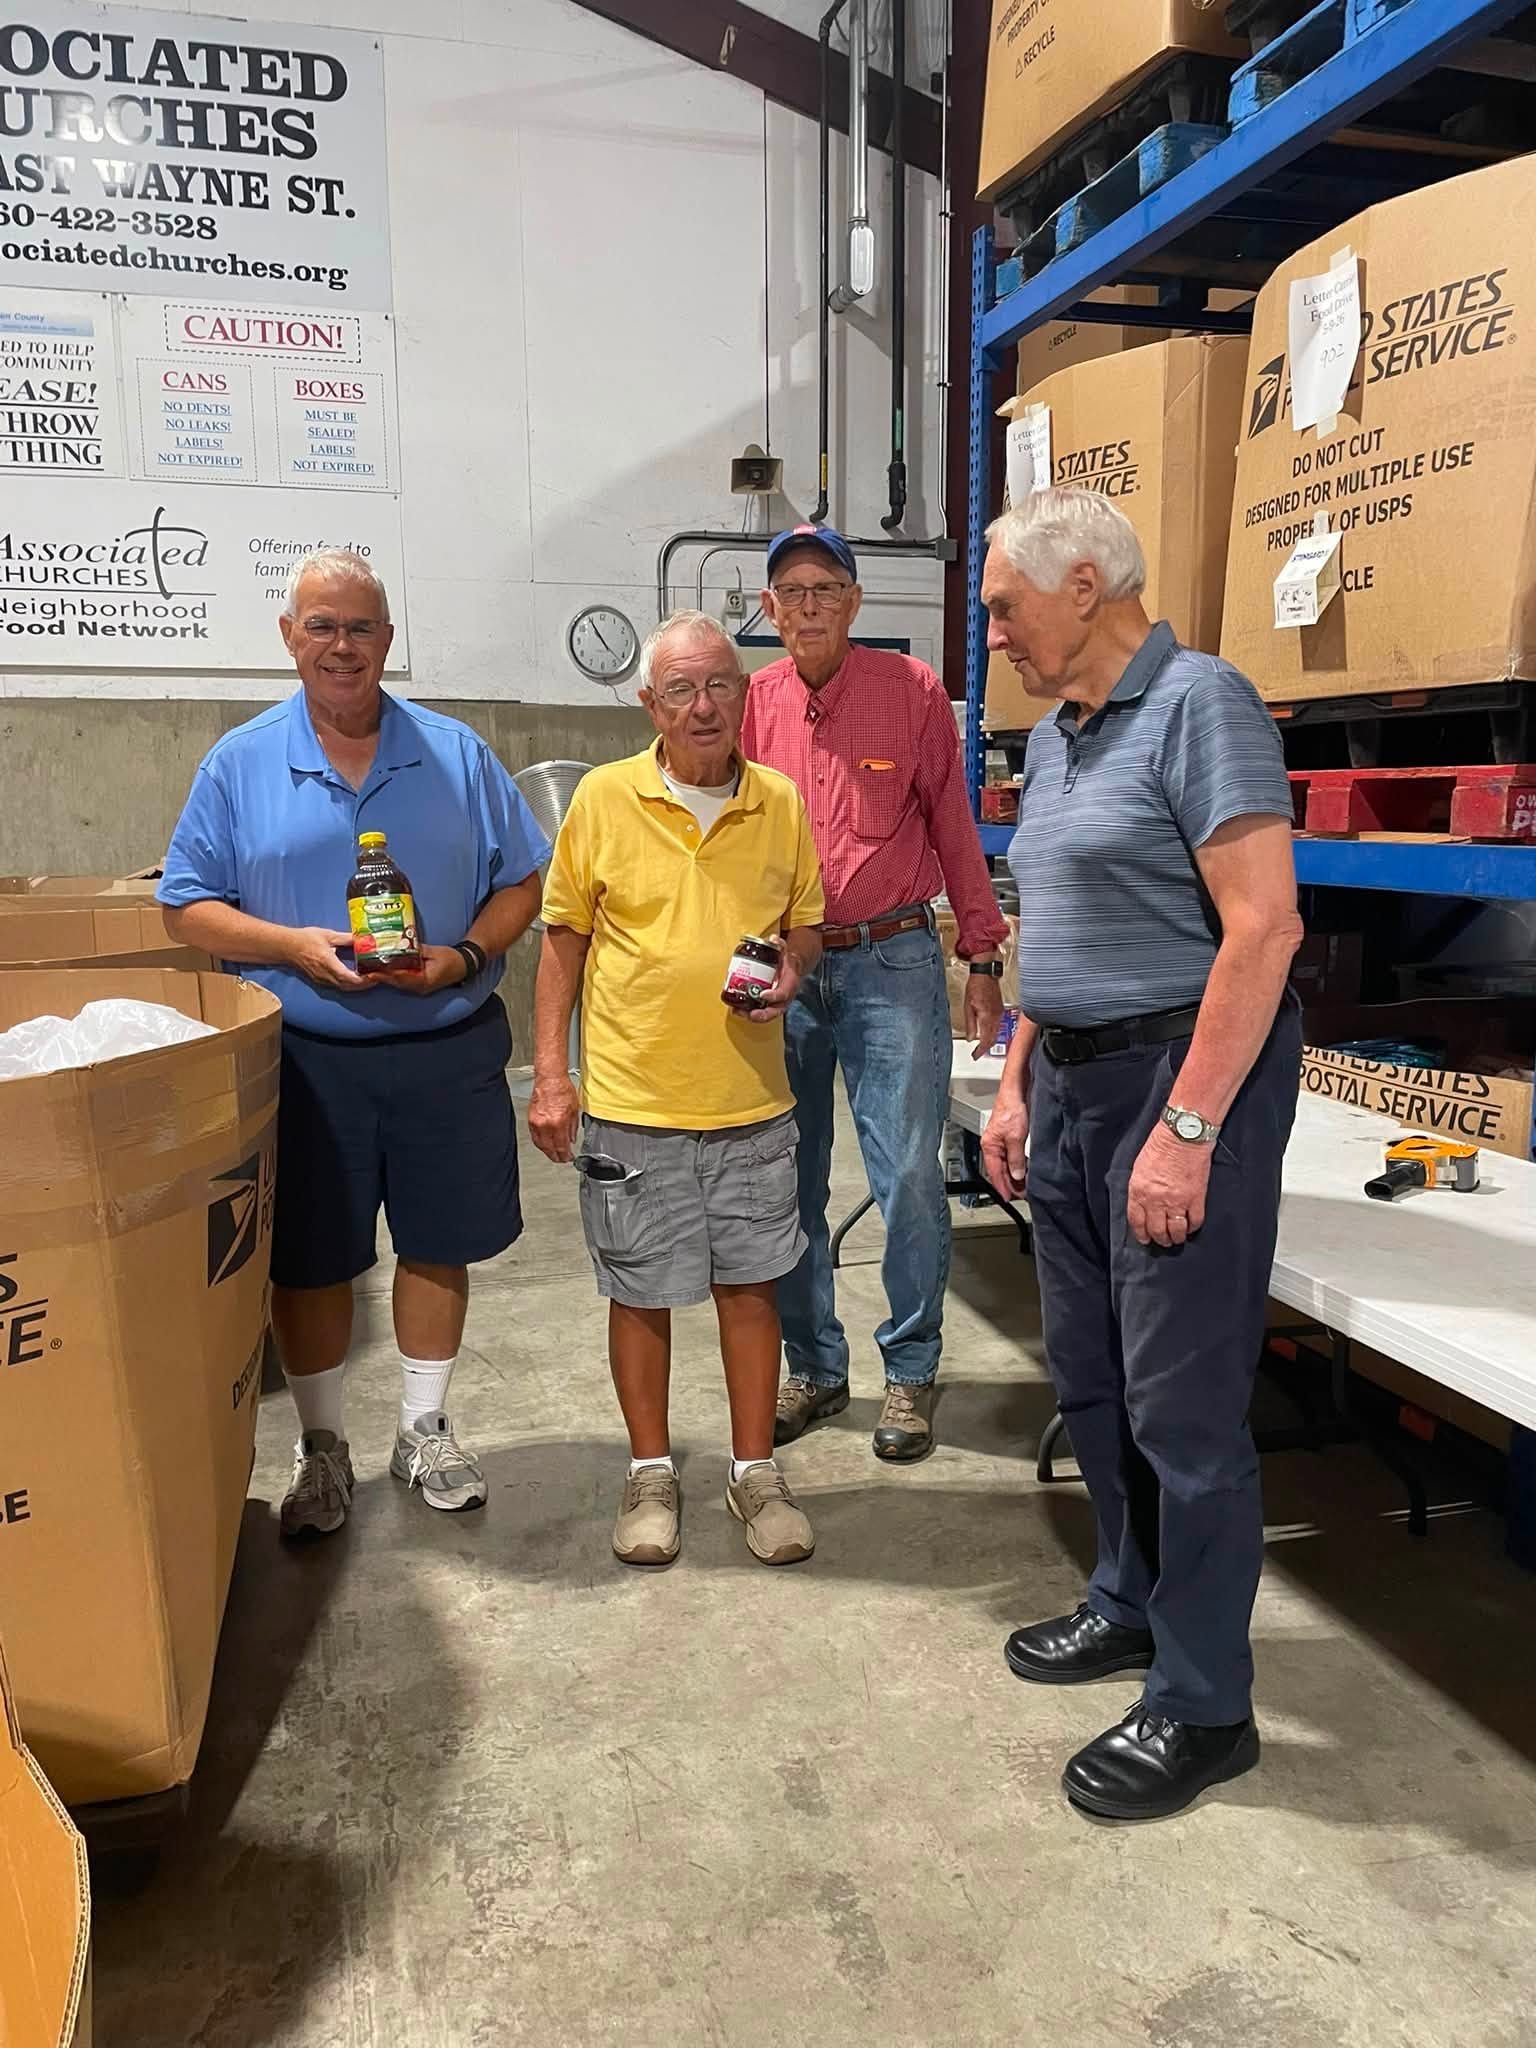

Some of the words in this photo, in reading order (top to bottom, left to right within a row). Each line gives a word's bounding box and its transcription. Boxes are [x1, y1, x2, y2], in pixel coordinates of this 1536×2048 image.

[0, 24, 348, 102] OCIATED
[92, 158, 270, 211] WAYNE
[287, 175, 356, 218] ST.
[2, 238, 348, 291] ociatedchurches.org
[1376, 268, 1508, 340] STATES
[184, 315, 343, 349] CAUTION!
[26, 342, 48, 354] TO
[53, 343, 95, 357] HELP
[1366, 309, 1514, 385] SERVICE
[0, 355, 96, 372] OMMUNITY
[163, 371, 228, 391] CANS
[295, 379, 365, 400] BOXES
[163, 401, 183, 411] NO
[187, 403, 231, 415] DENTS!
[305, 410, 338, 420] MUST
[343, 412, 357, 422] BE
[0, 411, 99, 436] HROW
[166, 418, 184, 429] NO
[189, 420, 231, 432] LEAKS!
[308, 426, 356, 439] SEALED!
[0, 440, 103, 466] THING
[176, 436, 223, 449] LABELS!
[311, 444, 355, 456] LABELS!
[158, 453, 184, 463] NOT
[189, 454, 242, 466] EXPIRED!
[1057, 440, 1131, 481] STATES
[1292, 455, 1312, 479] DO
[1316, 441, 1345, 471] NOT
[1349, 428, 1385, 458] CUT
[293, 460, 318, 470] NOT
[322, 462, 374, 473] EXPIRED!
[1245, 490, 1300, 529] DESIGNED
[1304, 480, 1331, 509] FOR
[1336, 454, 1424, 500] MULTIPLE
[1431, 442, 1474, 474] USE
[1267, 513, 1335, 552] PROPEY
[1340, 506, 1361, 533] OF
[1366, 494, 1413, 525] USPS
[0, 566, 148, 587] HURCHES
[0, 619, 66, 635] ood
[77, 621, 209, 639] Network
[1377, 1087, 1501, 1141] SERVICE
